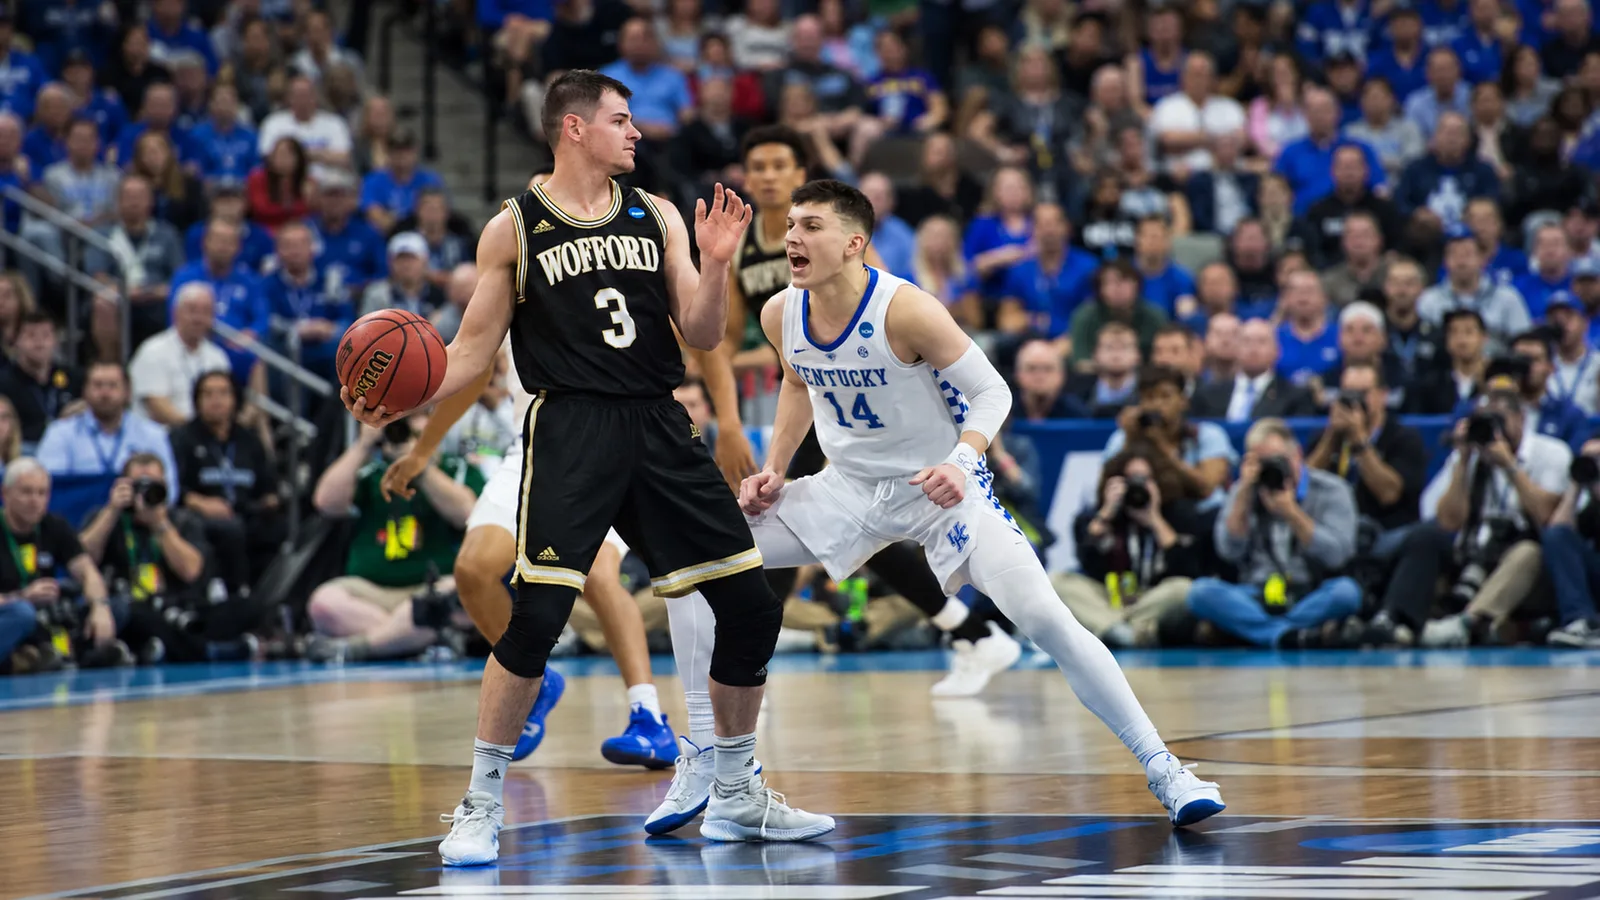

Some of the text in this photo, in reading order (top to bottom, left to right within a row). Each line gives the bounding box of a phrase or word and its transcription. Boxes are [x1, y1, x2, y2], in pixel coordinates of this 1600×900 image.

[535, 234, 660, 287] WOFFORD
[593, 286, 637, 349] 3
[791, 362, 888, 388] KENTUCKY
[823, 391, 886, 429] 14
